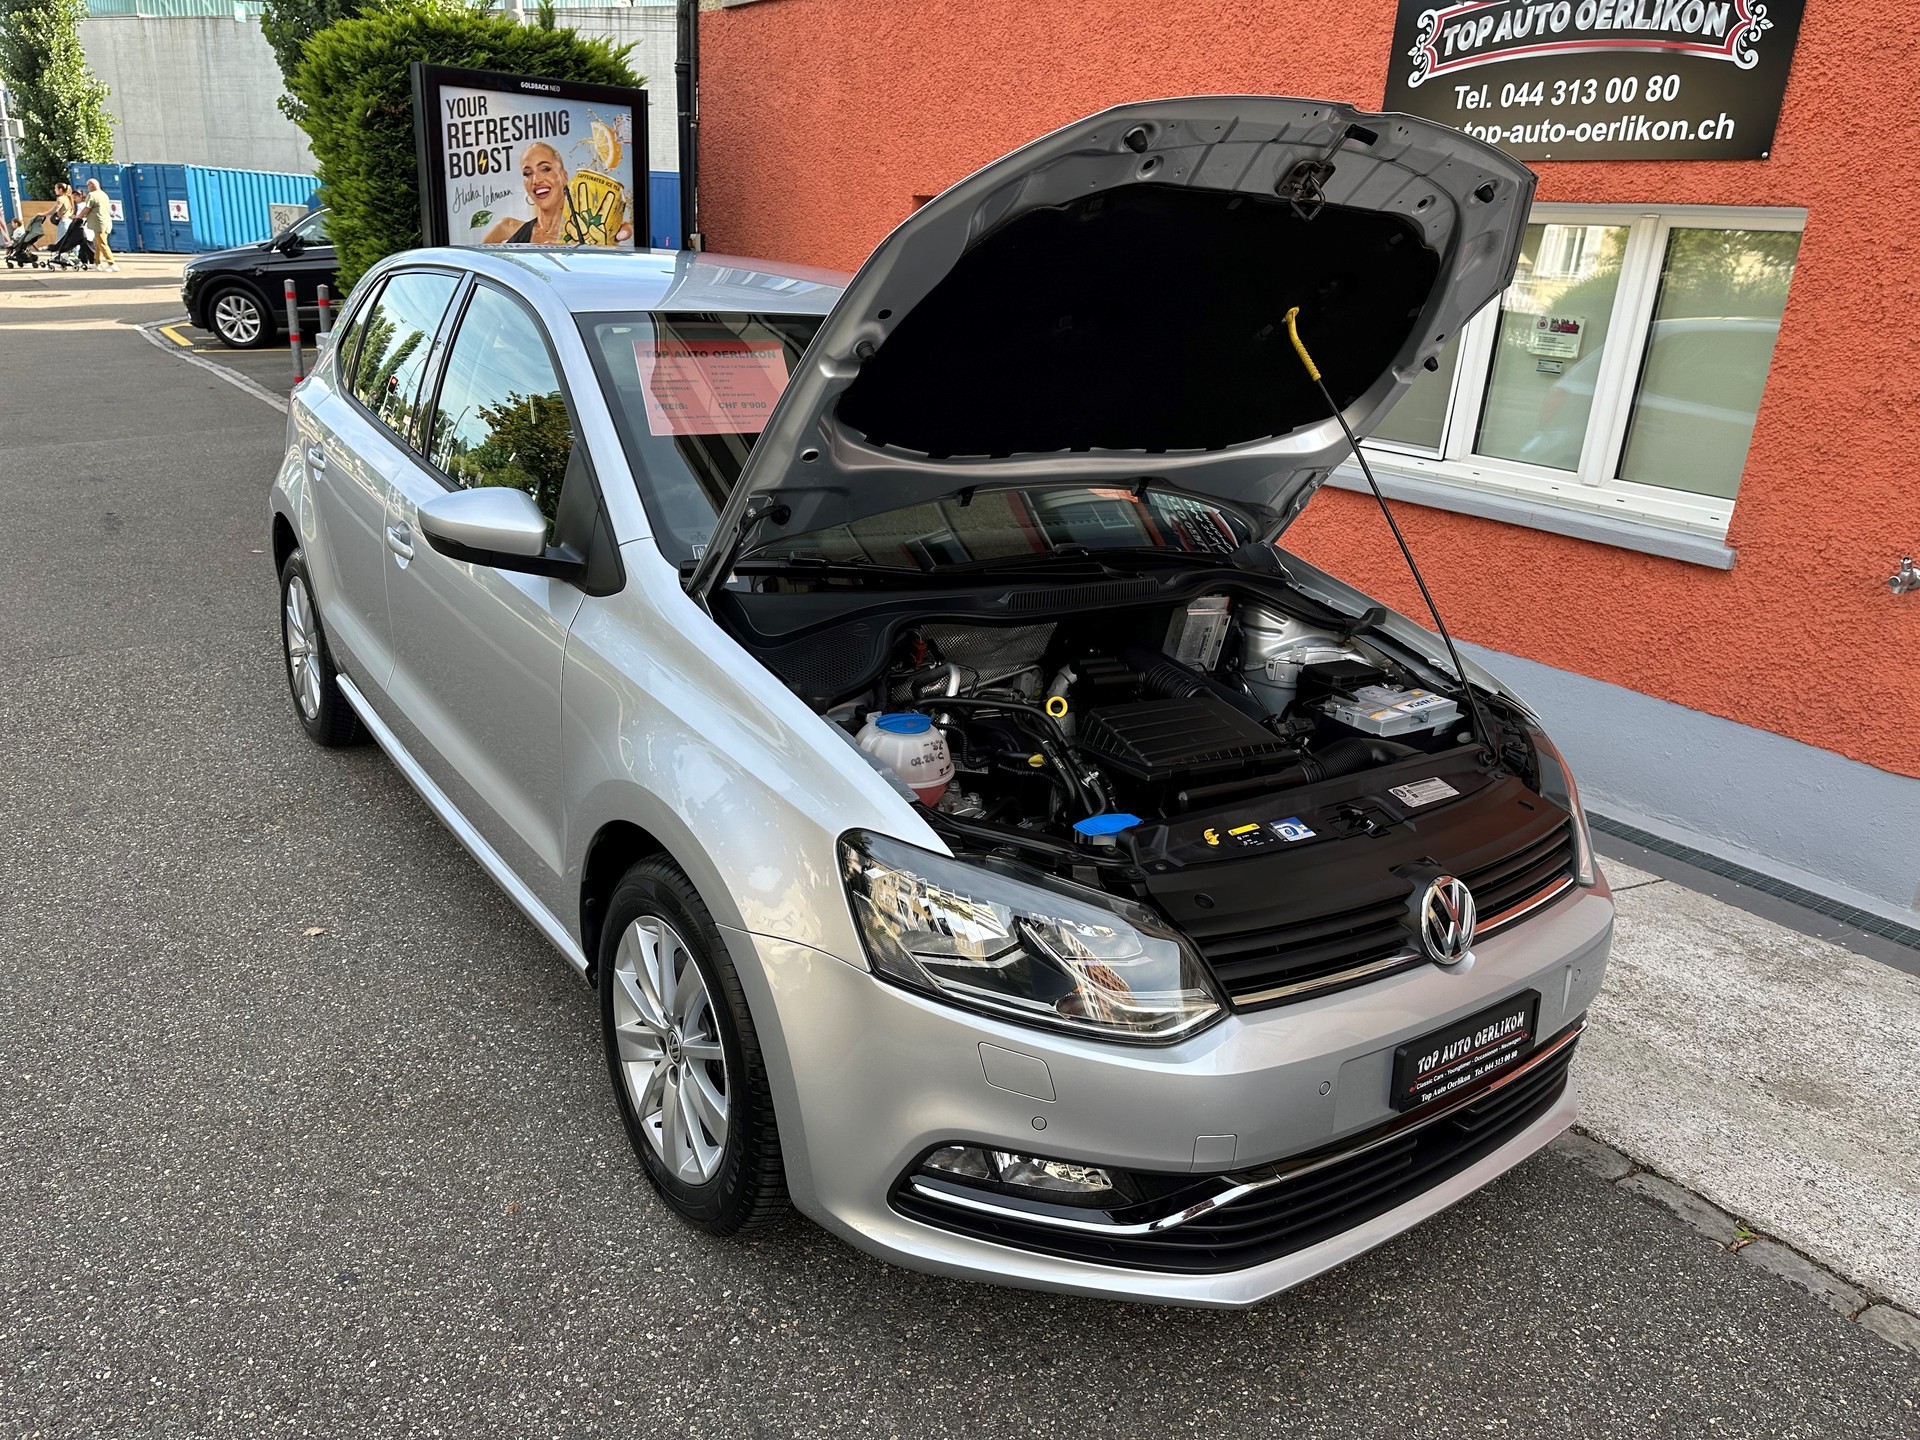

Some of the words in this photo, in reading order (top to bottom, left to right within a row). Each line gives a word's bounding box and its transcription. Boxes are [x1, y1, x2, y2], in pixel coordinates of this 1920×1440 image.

[1443, 15, 1494, 56] TOP
[1492, 1, 1571, 43] AUTO
[1575, 0, 1730, 37] OERLIKON
[520, 81, 549, 91] GOLDBACH
[550, 84, 561, 92] NEO
[1454, 85, 1493, 110] Tel.
[1500, 82, 1543, 108] 044
[1551, 79, 1596, 106] 313
[1605, 77, 1638, 104] 00
[1647, 74, 1680, 102] 80
[446, 95, 488, 119] YOUR
[447, 109, 570, 150] REFRESHING
[1455, 113, 1734, 144] top-auto-oerlikon.ch
[448, 145, 514, 179] BOOST
[644, 350, 669, 359] TOP
[673, 350, 709, 359] AUTO
[712, 350, 776, 359] OERLIKON
[654, 402, 688, 411] PREIS:
[741, 401, 767, 409] 9'900
[1417, 1049, 1439, 1074] TOP
[1441, 1036, 1471, 1064] AUTO
[1474, 1011, 1525, 1048] OERLIKON
[1416, 1079, 1433, 1090] Classic
[1433, 1073, 1444, 1083] Cars
[1421, 1091, 1432, 1102] Top
[1433, 1086, 1446, 1097] Auto
[1447, 1074, 1471, 1089] Oerlikon
